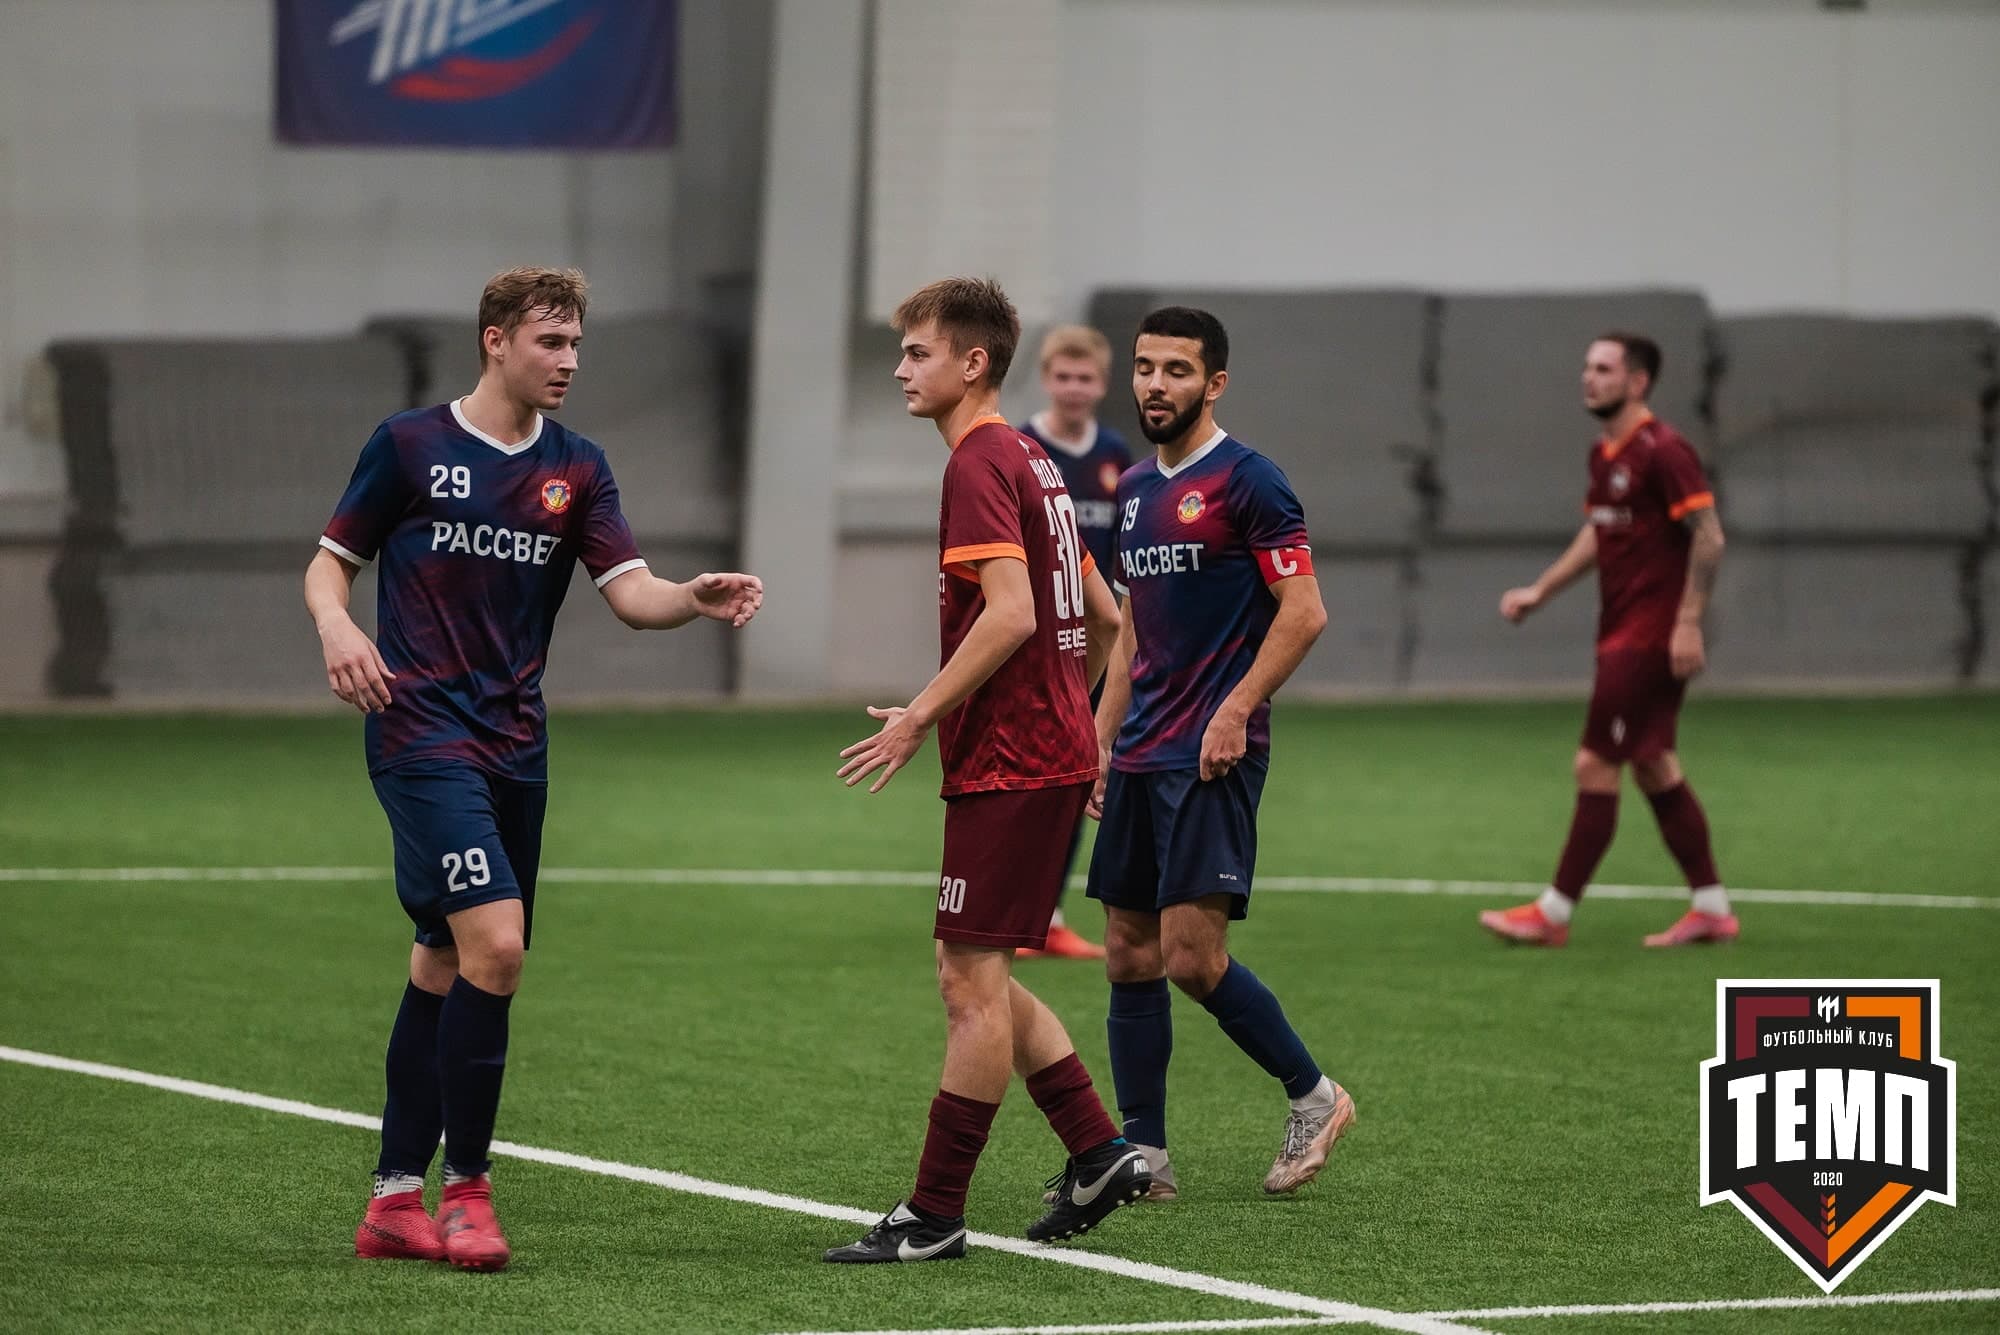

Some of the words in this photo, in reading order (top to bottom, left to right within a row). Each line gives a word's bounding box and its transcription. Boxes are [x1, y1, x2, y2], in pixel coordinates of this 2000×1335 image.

[430, 464, 471, 498] 29
[1121, 496, 1140, 532] 19
[431, 521, 562, 565] РАССВЕТ
[1043, 494, 1085, 619] 30
[441, 847, 491, 893] 29
[938, 875, 967, 914] 30
